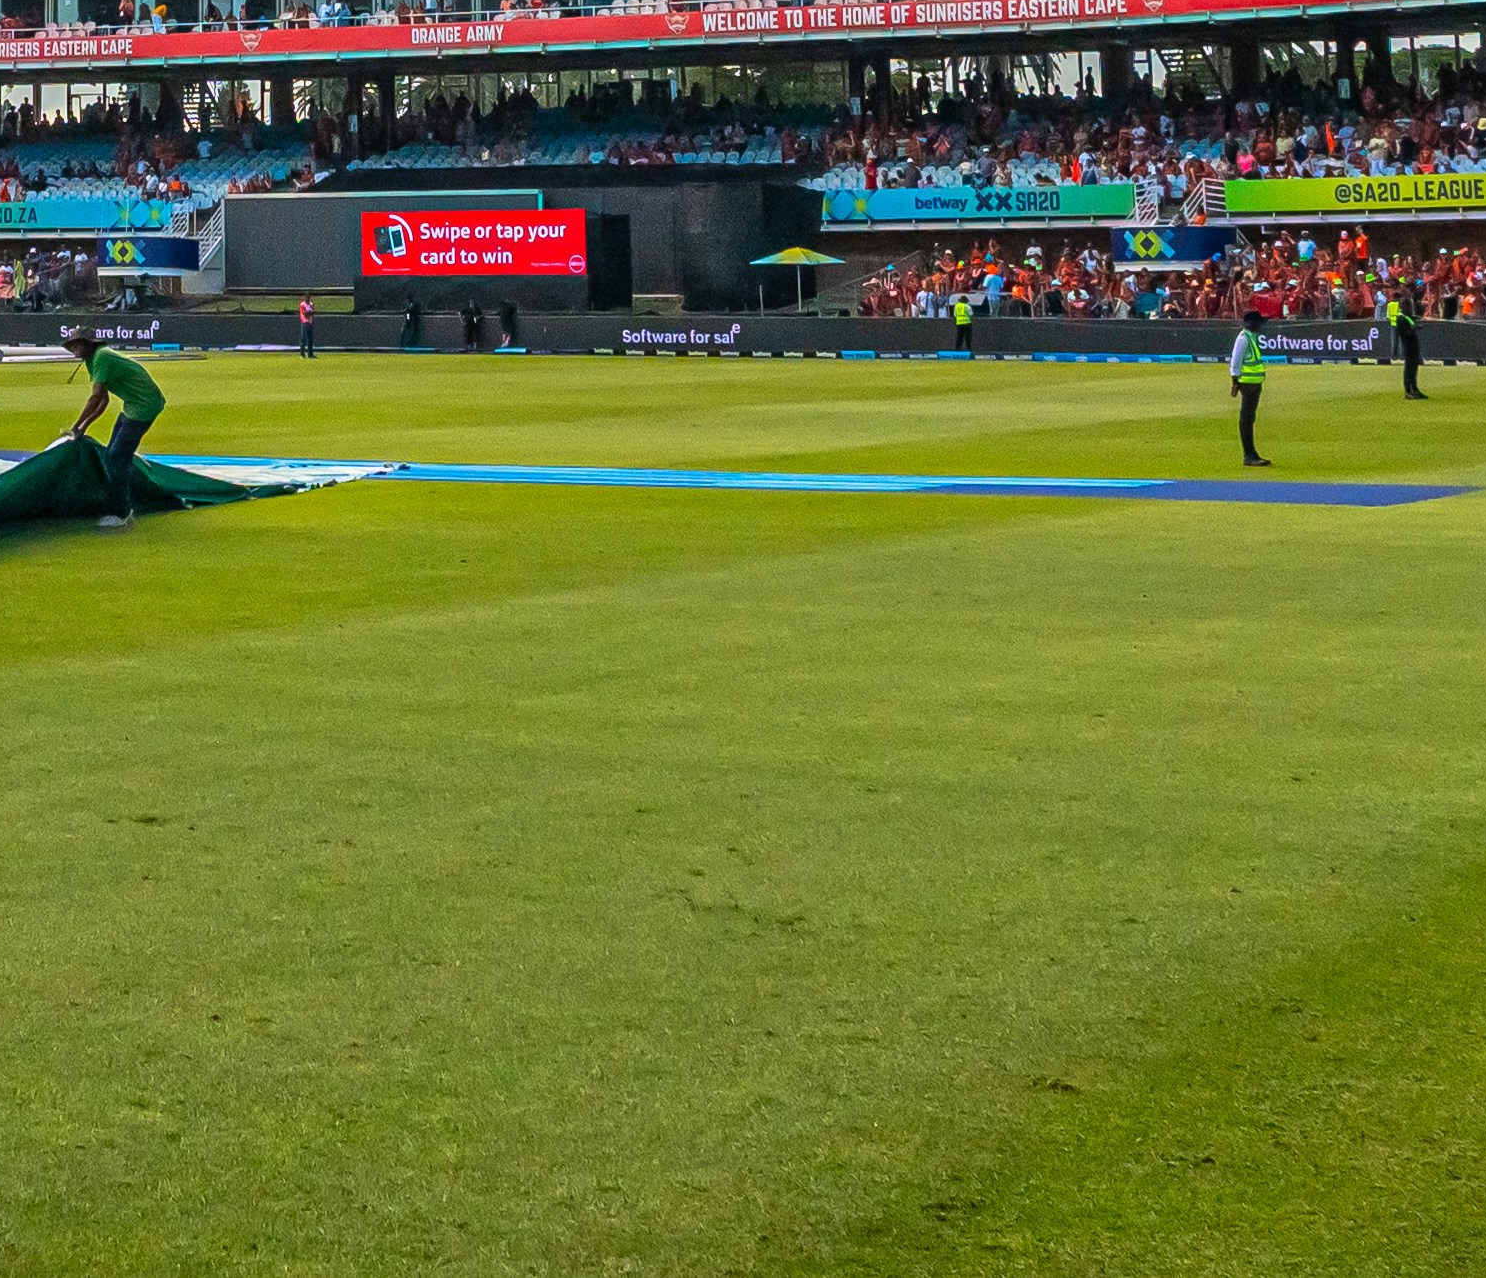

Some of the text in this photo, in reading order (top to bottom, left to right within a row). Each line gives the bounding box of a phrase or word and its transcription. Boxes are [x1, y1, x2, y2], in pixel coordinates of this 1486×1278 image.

[702, 10, 779, 32] WELCOME
[784, 9, 803, 28] TO
[808, 7, 837, 27] THE
[842, 6, 885, 26] HOME
[891, 4, 911, 24] OF
[916, 0, 1003, 23] SUNRISERS
[411, 24, 504, 44] ORANGE ARMY
[44, 40, 97, 56] EASTERN
[101, 38, 133, 55] CAPE
[914, 196, 968, 212] betway
[1016, 191, 1060, 212] SA20
[1334, 179, 1484, 203] @SA20_LEAGUE
[420, 222, 566, 243] Swipe or tap your
[420, 247, 513, 265] card to win
[117, 326, 133, 339] for
[623, 323, 741, 344] Software for sale
[1258, 327, 1379, 351] Software for sale
